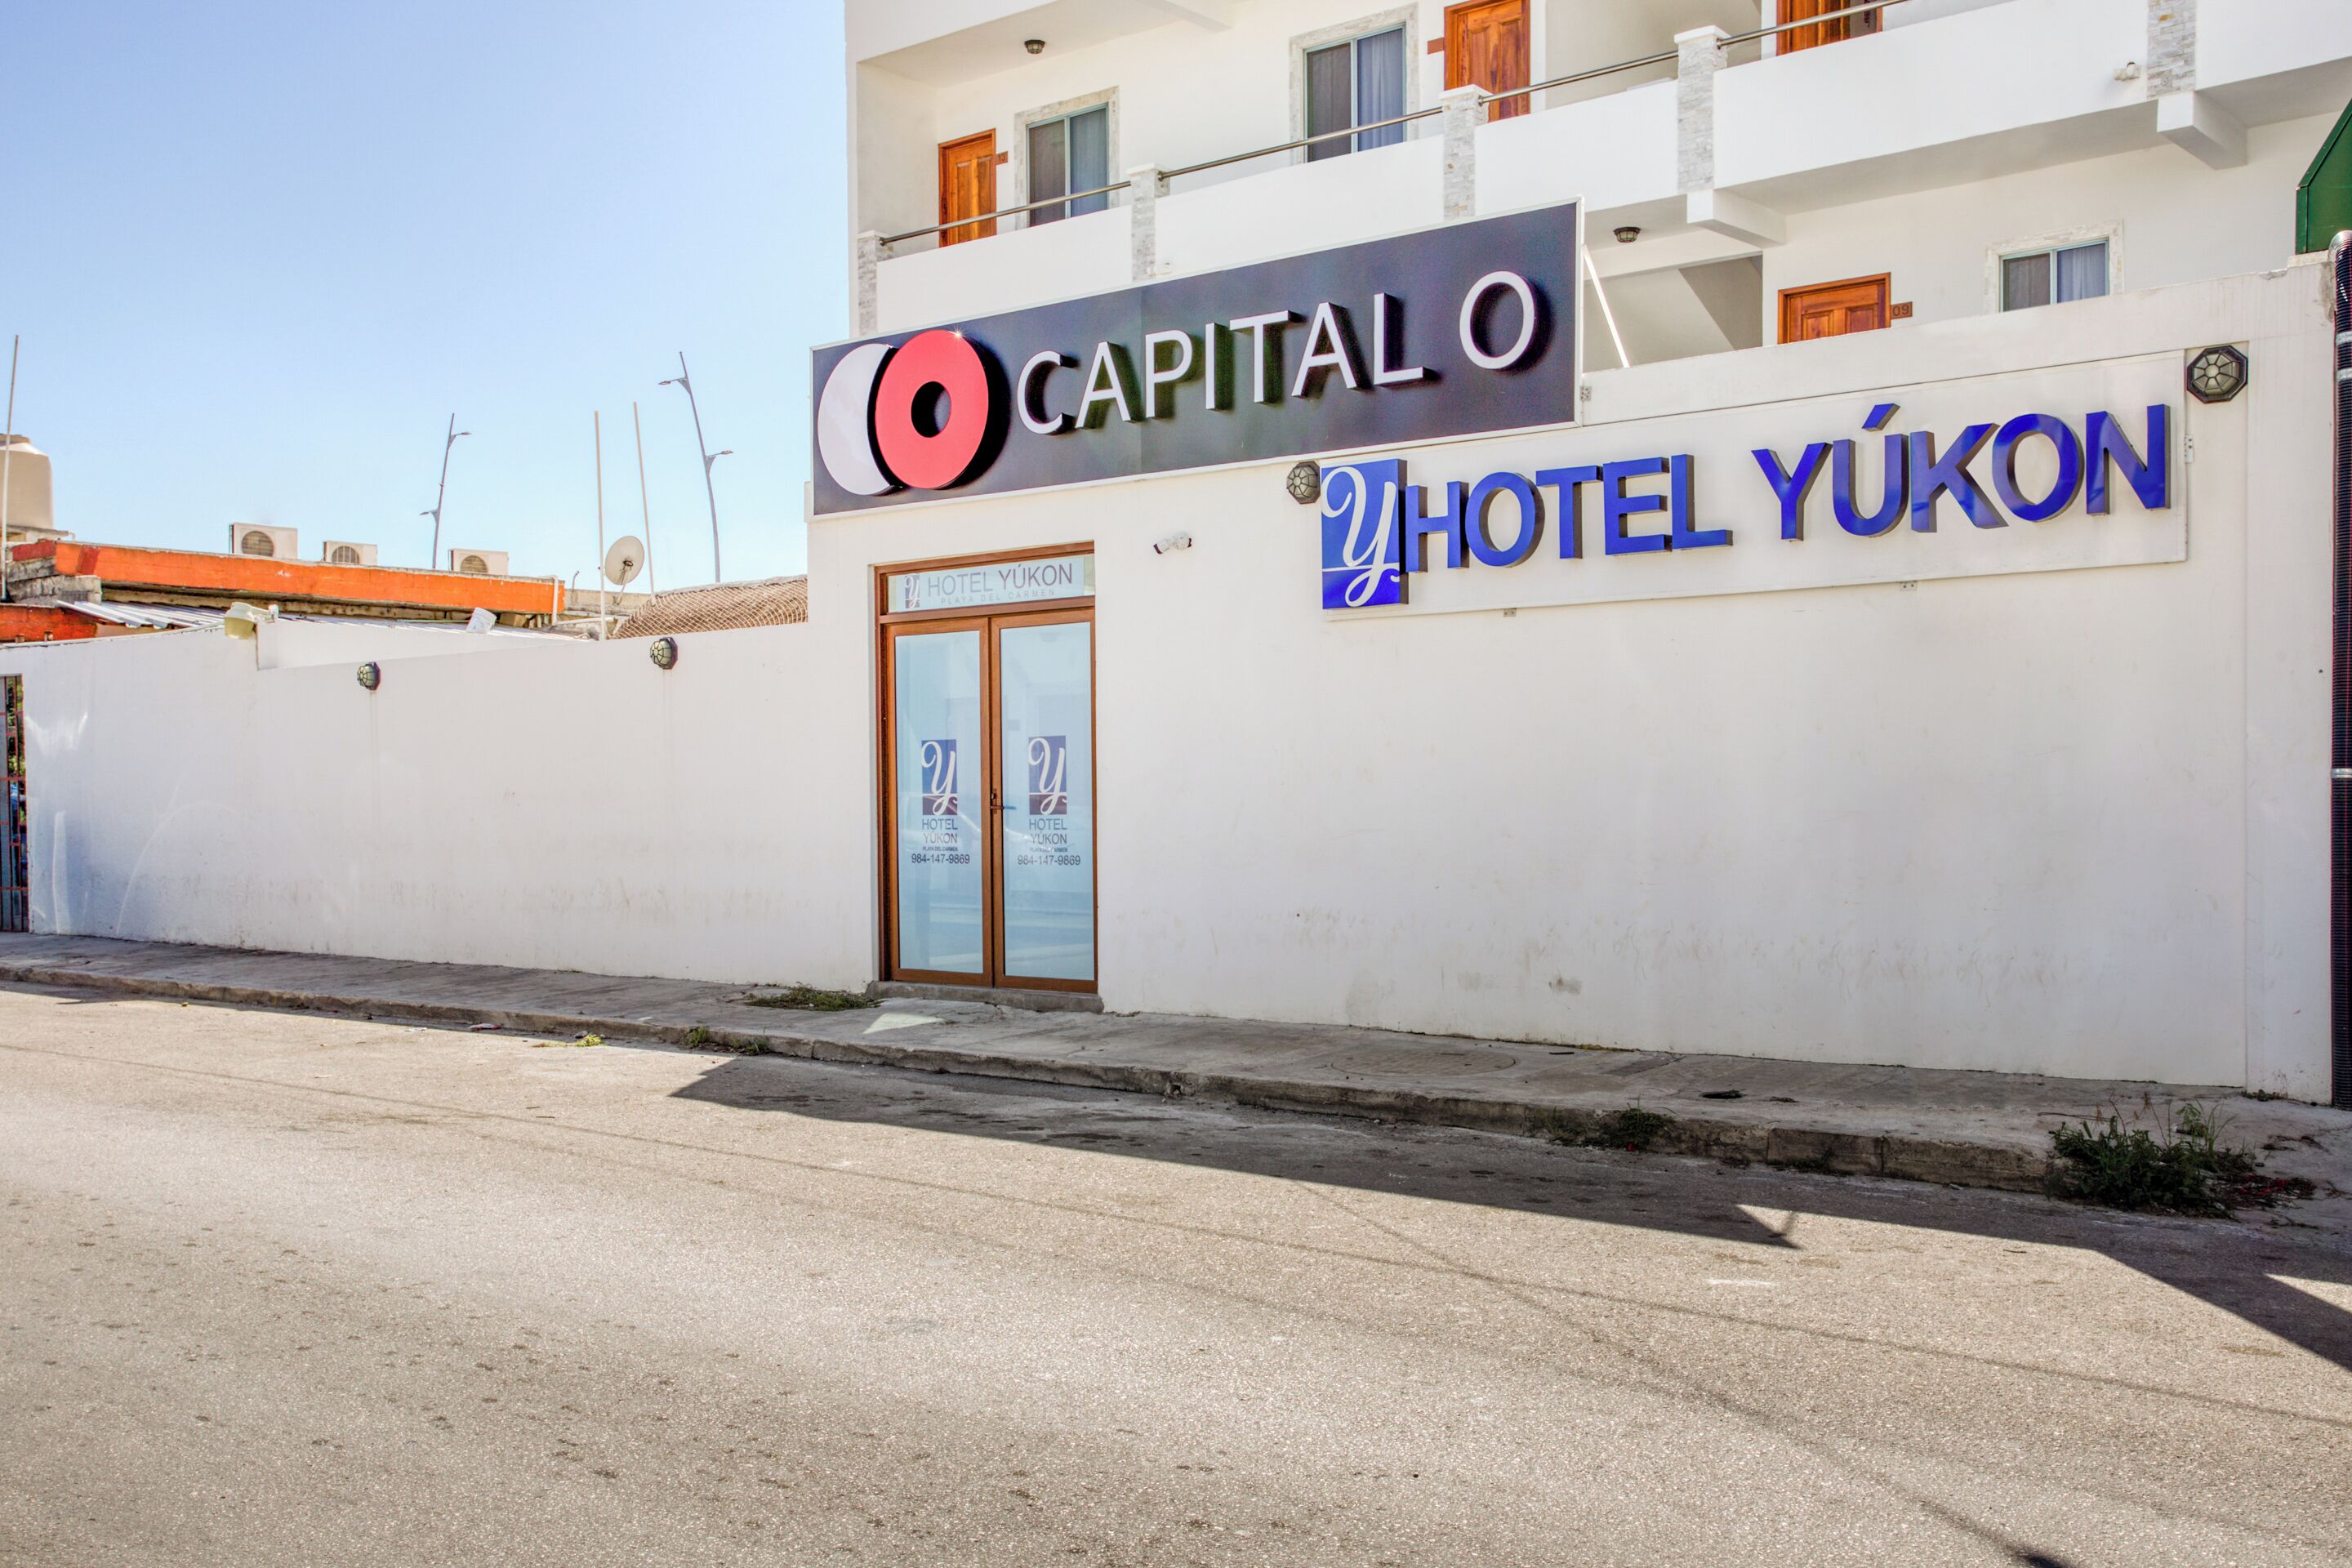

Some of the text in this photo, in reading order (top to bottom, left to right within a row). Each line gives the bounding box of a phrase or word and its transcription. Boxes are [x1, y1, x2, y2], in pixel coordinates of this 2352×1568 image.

[1892, 304, 1909, 317] 09
[1017, 270, 1539, 434] CAPITAL O
[1406, 452, 1733, 573] HOTEL
[1751, 403, 2174, 541] YÚKON
[928, 571, 994, 598] HOTEL
[998, 562, 1073, 590] YÚKON
[941, 588, 1055, 606] PLAYA DEL CARMEN
[922, 818, 958, 830] HOTEL
[1029, 818, 1067, 830] HOTEL
[911, 853, 970, 864] 984-147-9869
[1018, 854, 1081, 866] 984-147-9869
